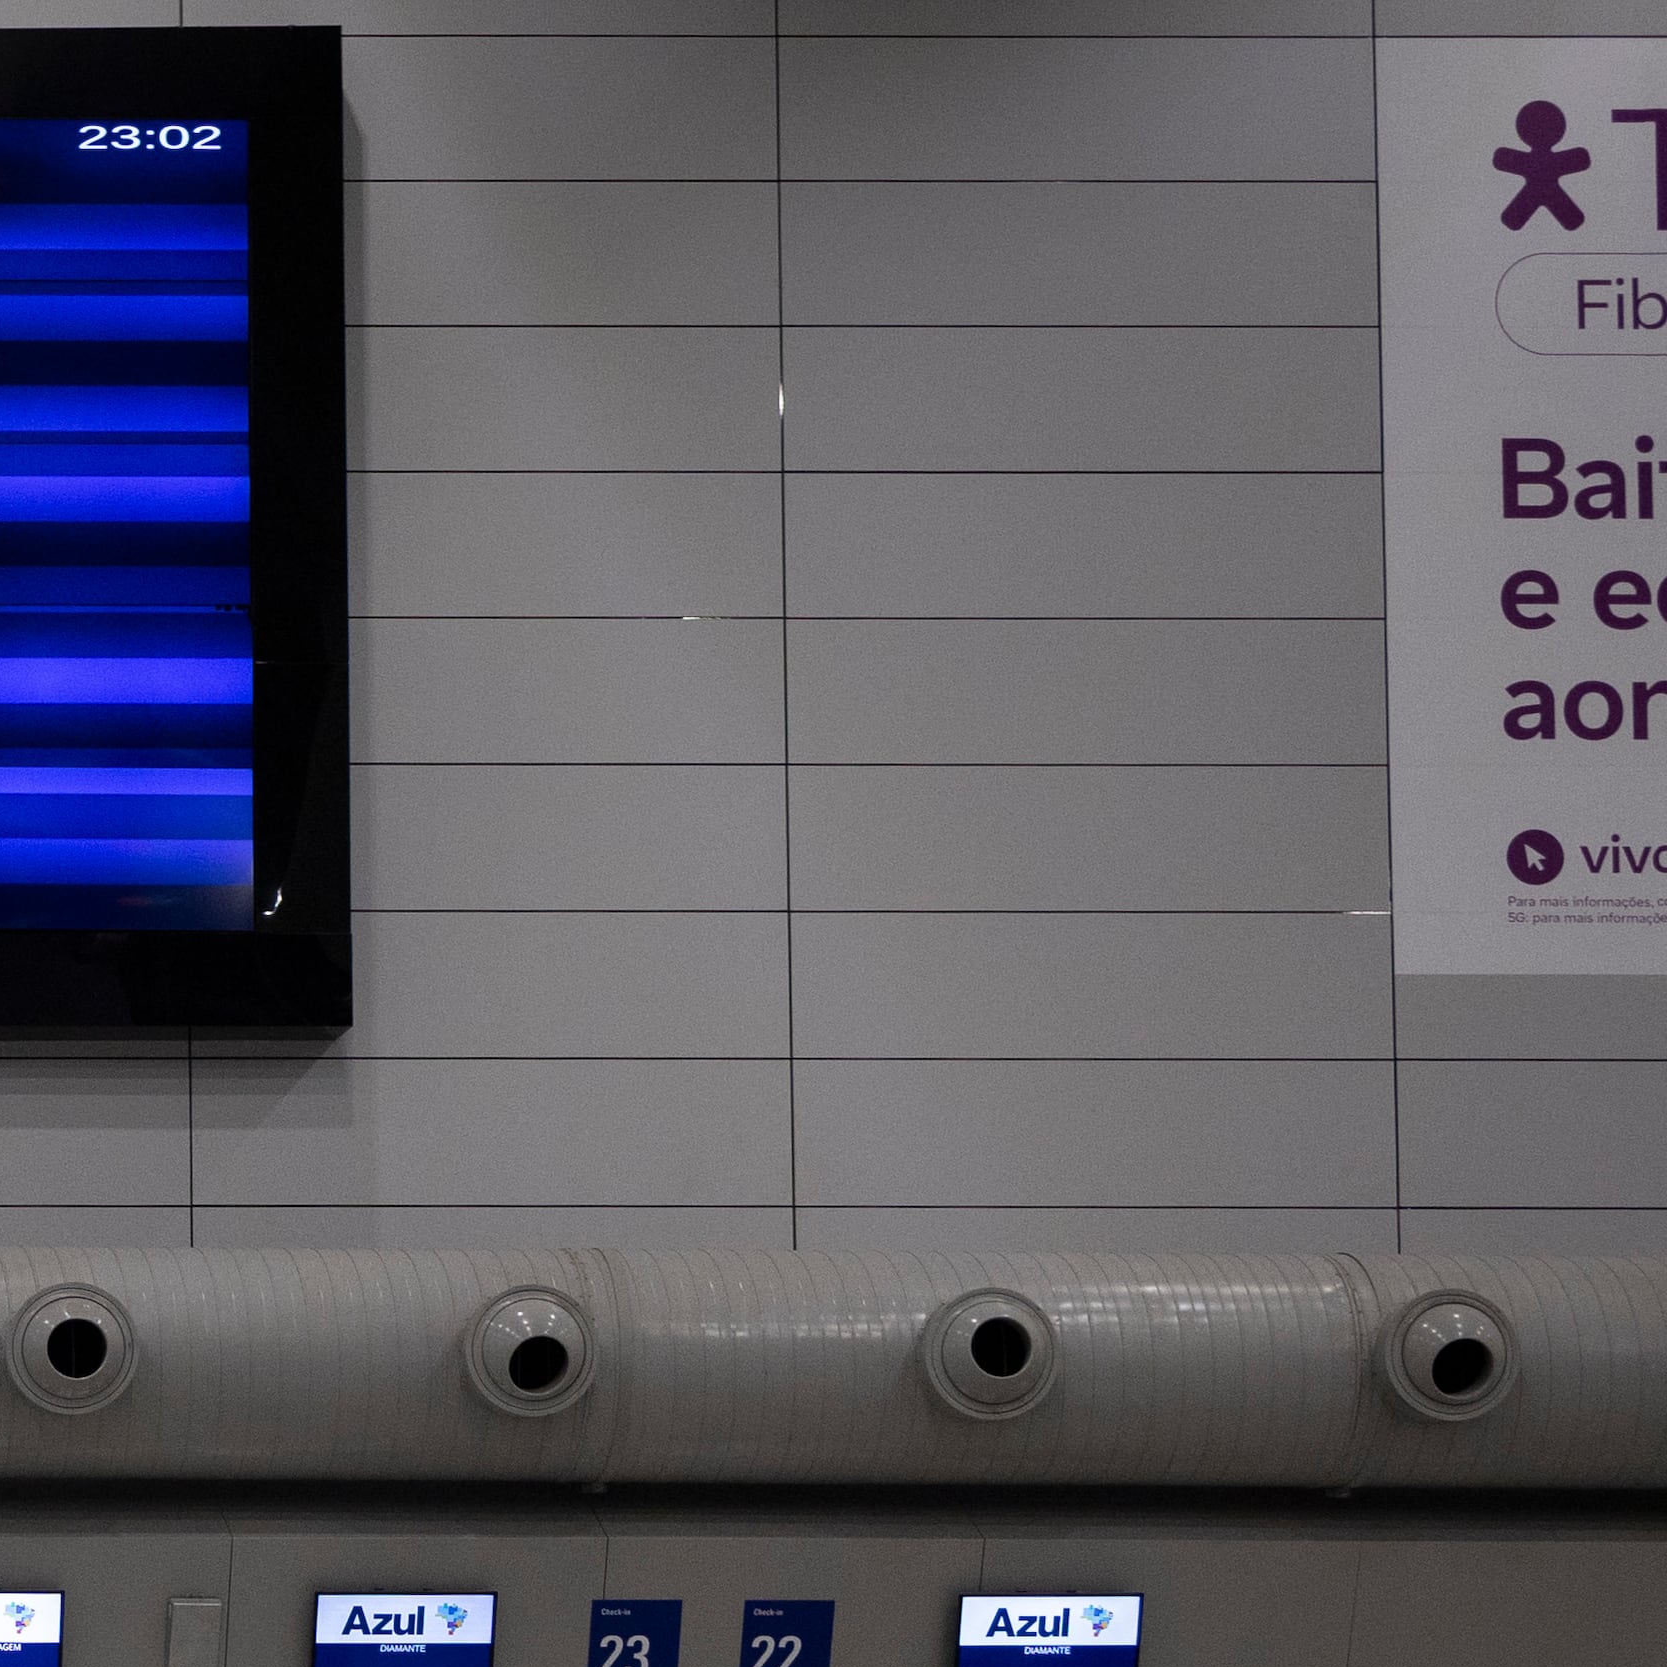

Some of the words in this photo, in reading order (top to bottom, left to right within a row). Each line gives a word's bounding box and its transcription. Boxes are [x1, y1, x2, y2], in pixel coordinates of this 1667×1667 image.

[78, 124, 222, 150] 23:02
[1501, 435, 1667, 520] Bai
[1500, 569, 1559, 630] e
[1593, 569, 1667, 631] e
[1507, 895, 1536, 908] Para
[1539, 896, 1569, 908] mais
[1532, 914, 1561, 926] para
[1563, 914, 1594, 924] mais
[340, 1605, 425, 1636] Azul
[985, 1607, 1071, 1638] Azul
[379, 1644, 427, 1653] DIAMANTE
